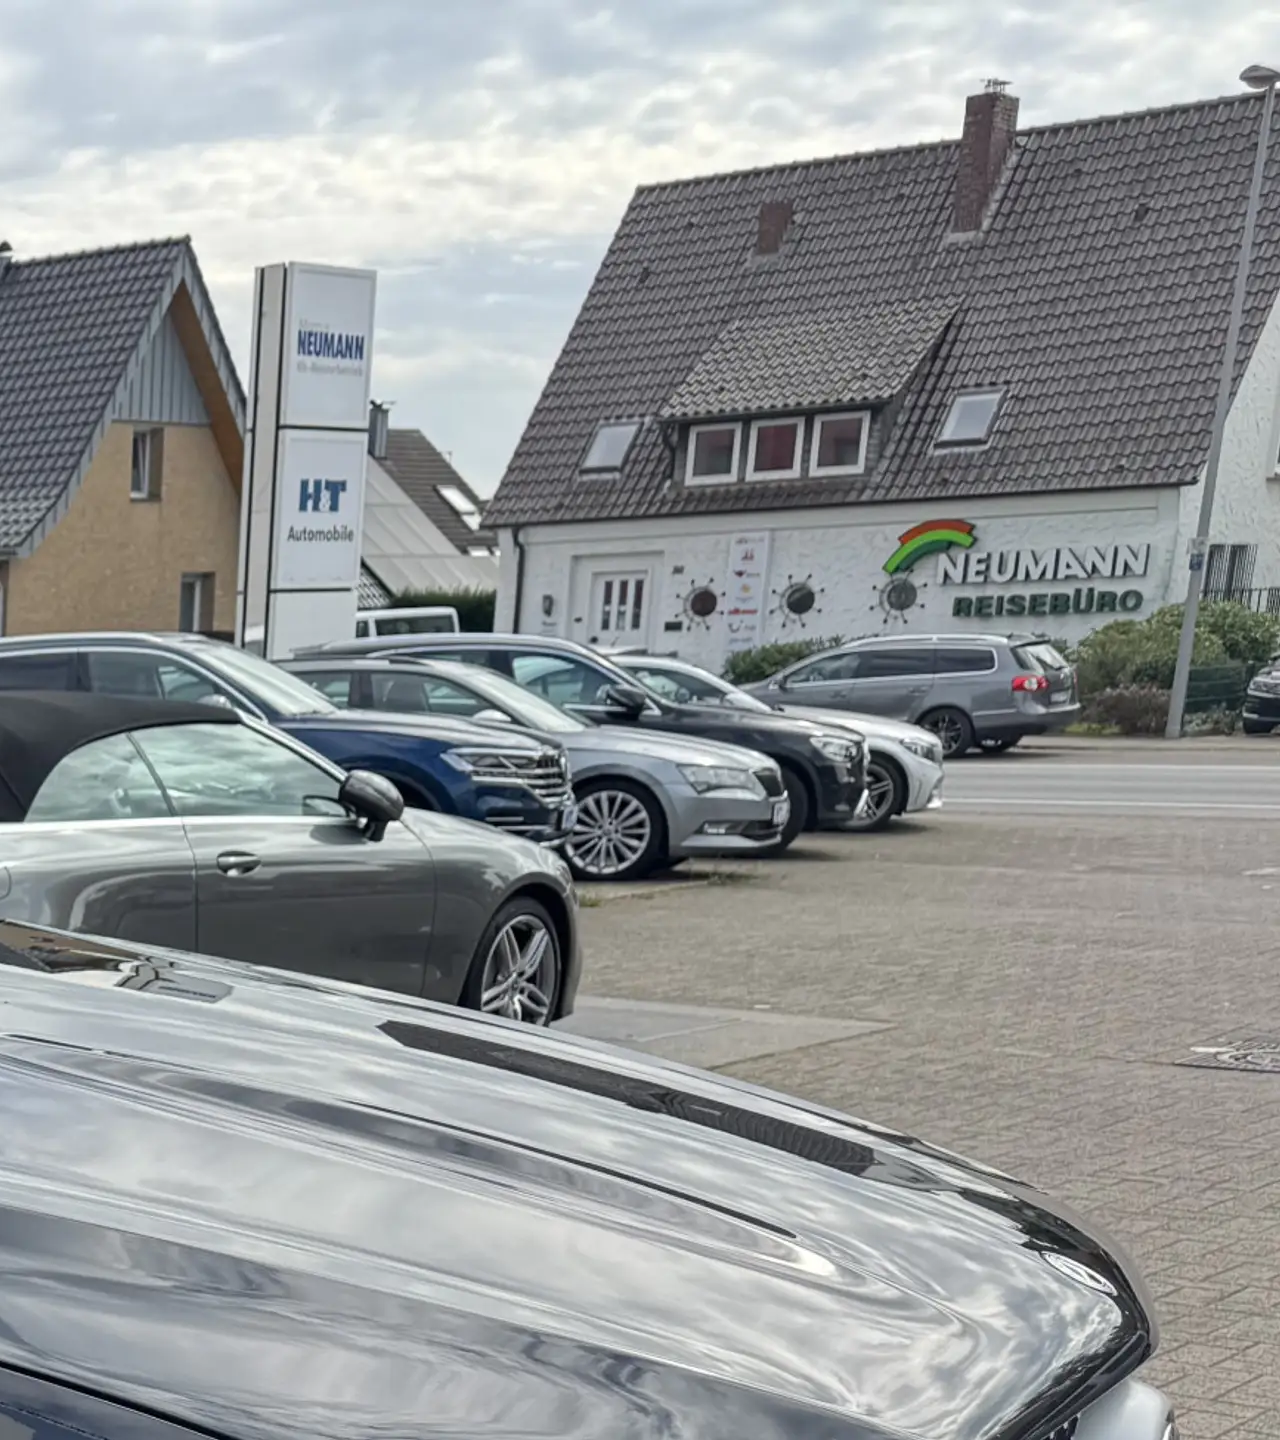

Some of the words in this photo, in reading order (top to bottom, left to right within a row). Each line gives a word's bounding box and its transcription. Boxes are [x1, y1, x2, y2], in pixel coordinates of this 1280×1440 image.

[297, 329, 365, 361] NEUMANN
[298, 478, 347, 512] H&T
[287, 524, 354, 543] Automobile
[936, 543, 1151, 585] NEUMANN
[951, 587, 1144, 618] REISEBÜRO
